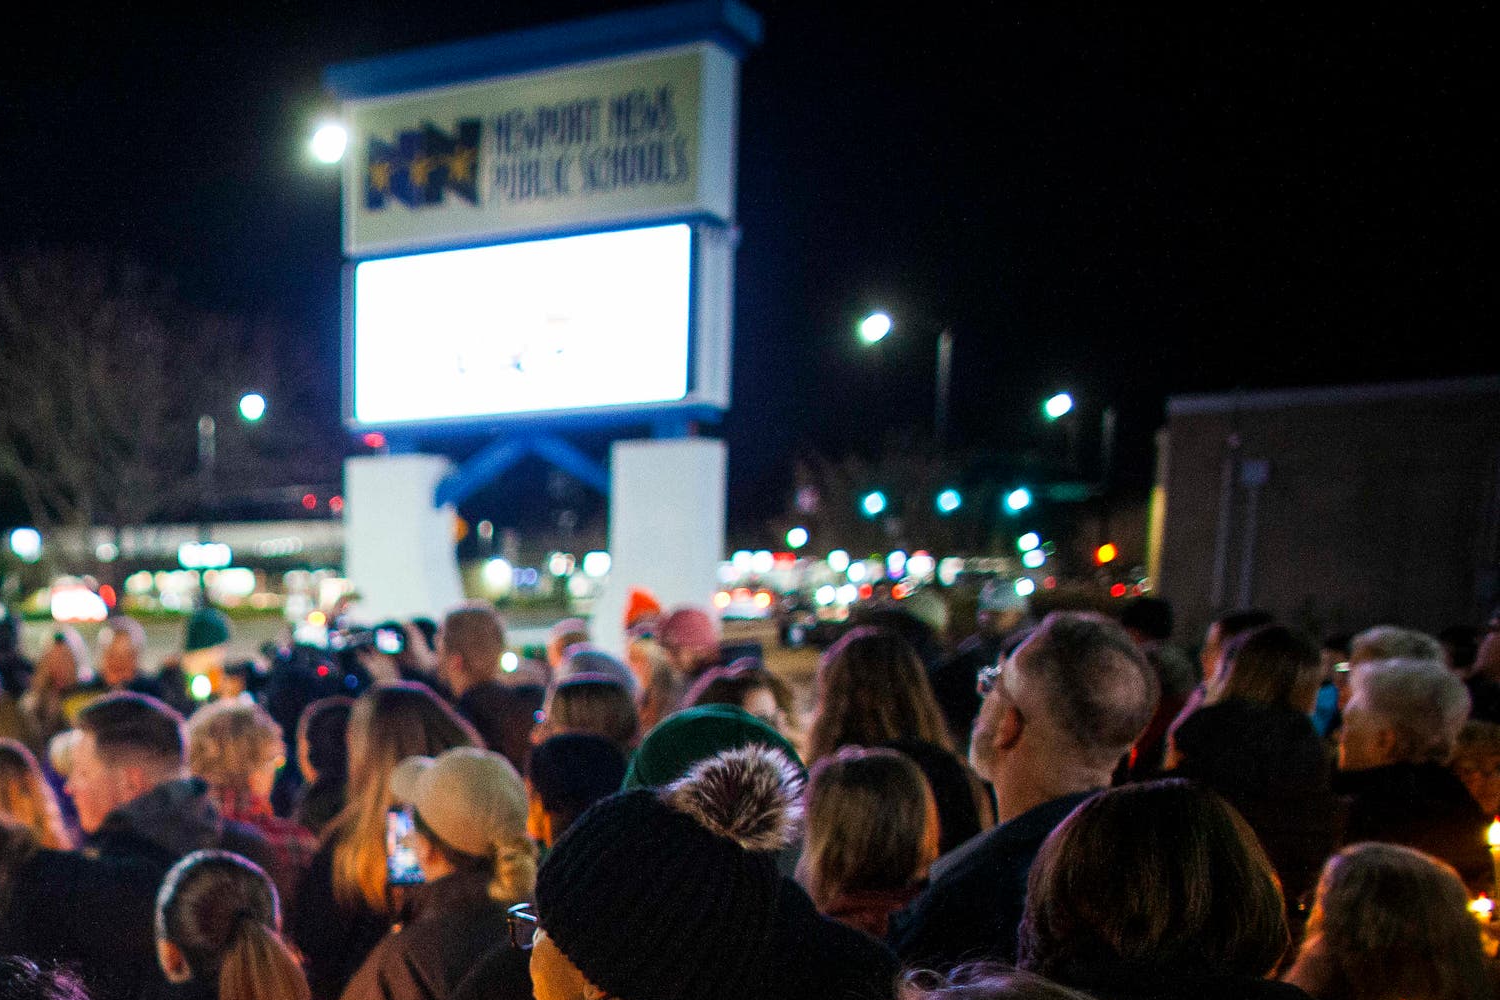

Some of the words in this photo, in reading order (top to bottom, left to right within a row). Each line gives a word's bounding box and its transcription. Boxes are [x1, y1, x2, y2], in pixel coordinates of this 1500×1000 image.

[495, 99, 600, 152] NEWPORT
[610, 83, 672, 138] NEWS
[496, 151, 570, 201] PUBLIC
[581, 134, 687, 192] SCHOOLS
